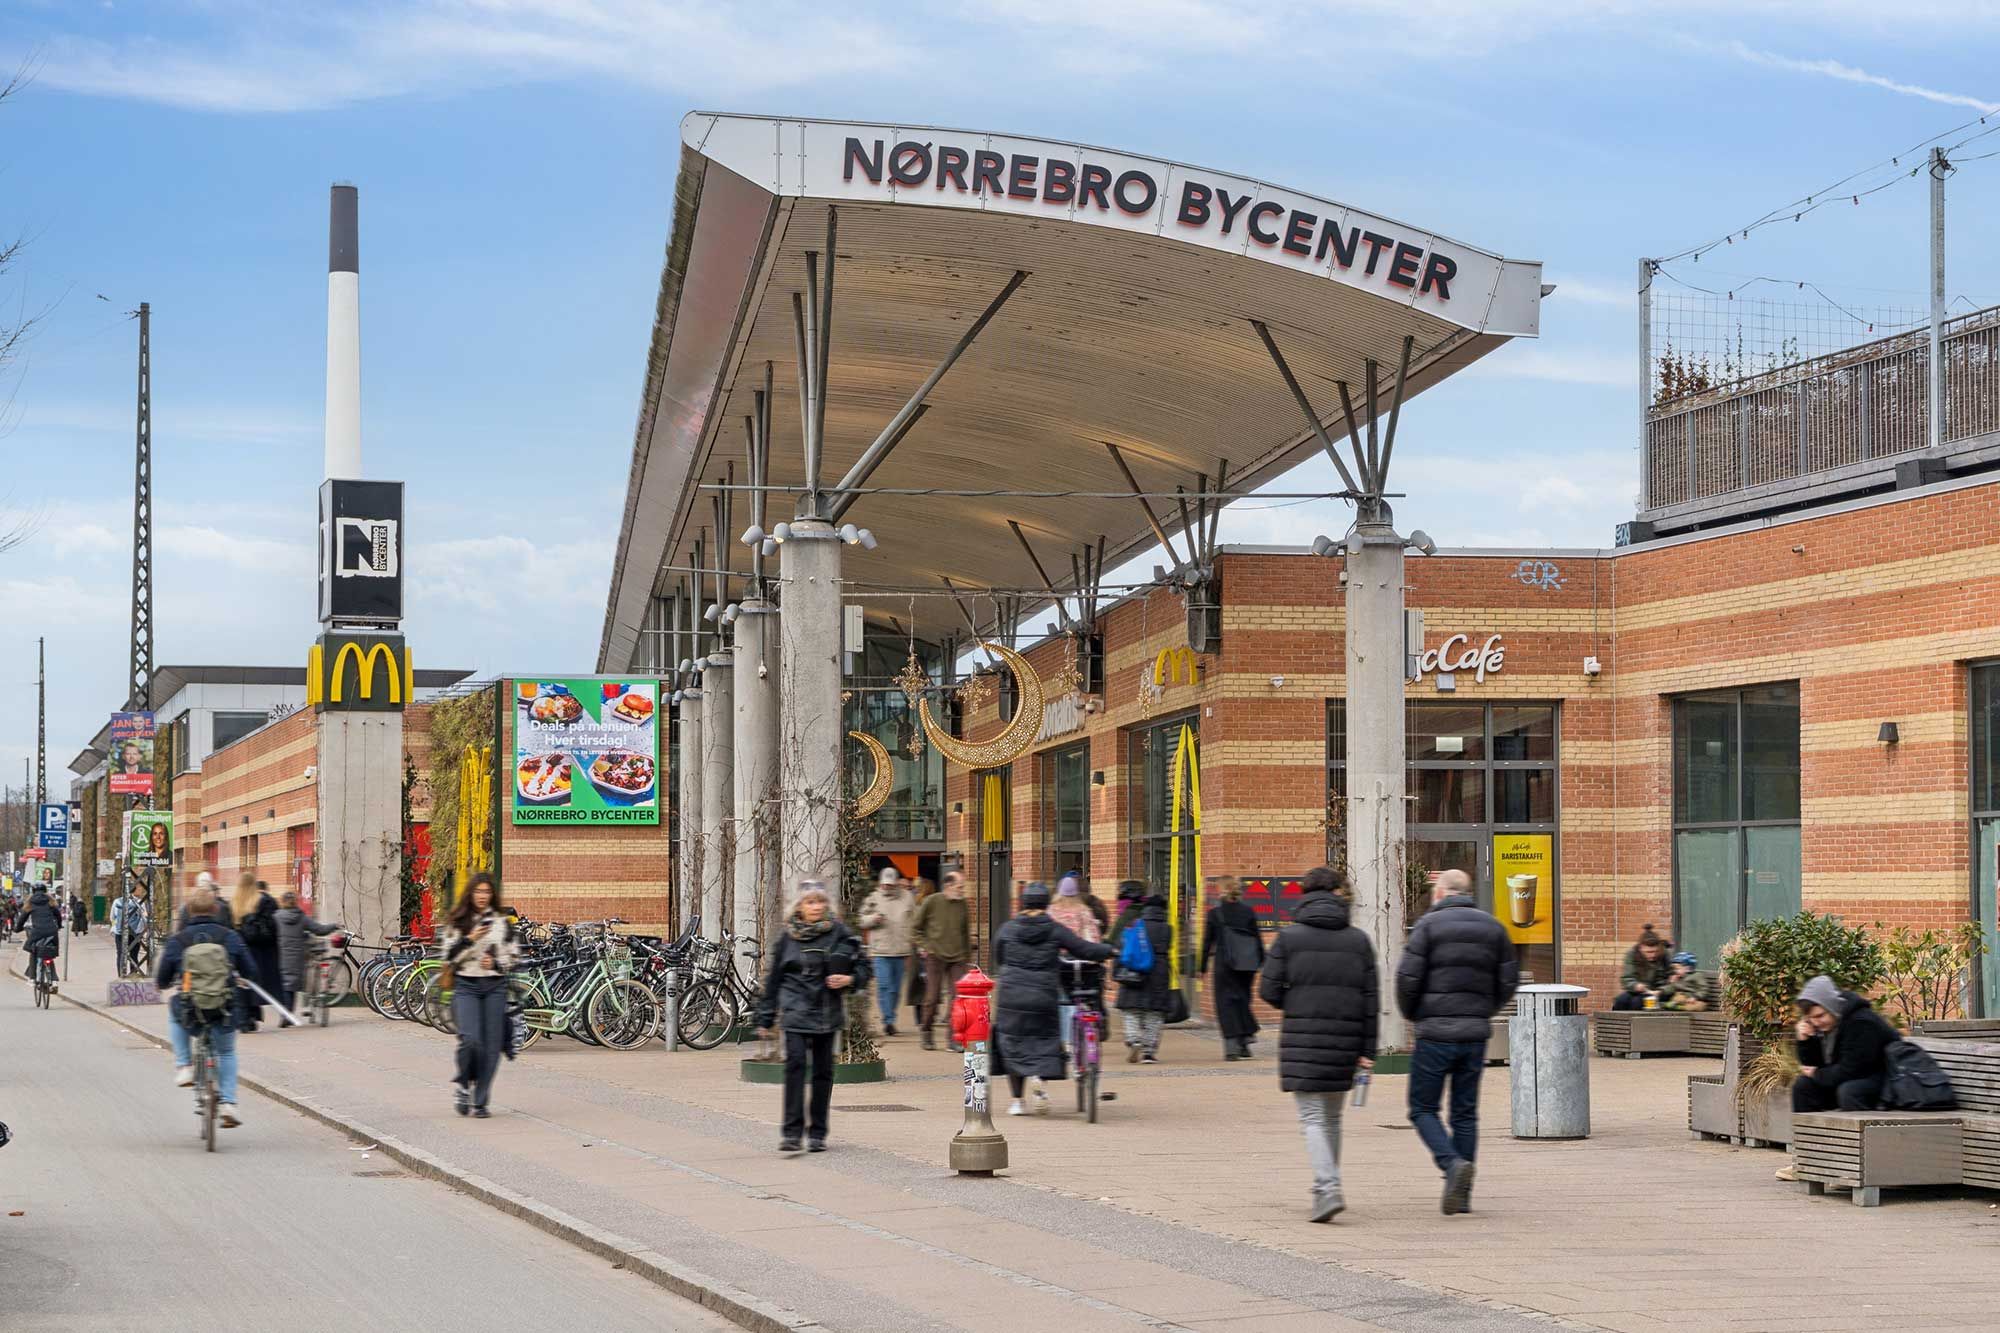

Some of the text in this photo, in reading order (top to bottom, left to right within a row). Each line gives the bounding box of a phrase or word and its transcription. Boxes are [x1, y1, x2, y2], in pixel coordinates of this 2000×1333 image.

[843, 137, 1458, 300] NØRREBRO BYCENTER
[379, 527, 387, 570] BYCENTER
[112, 719, 131, 728] JAN
[530, 720, 565, 731] Deals
[569, 720, 584, 733] på
[545, 734, 627, 748] Hver tirsdag!
[46, 807, 63, 829] P
[516, 810, 655, 821] NØRREBRO BYCENTER
